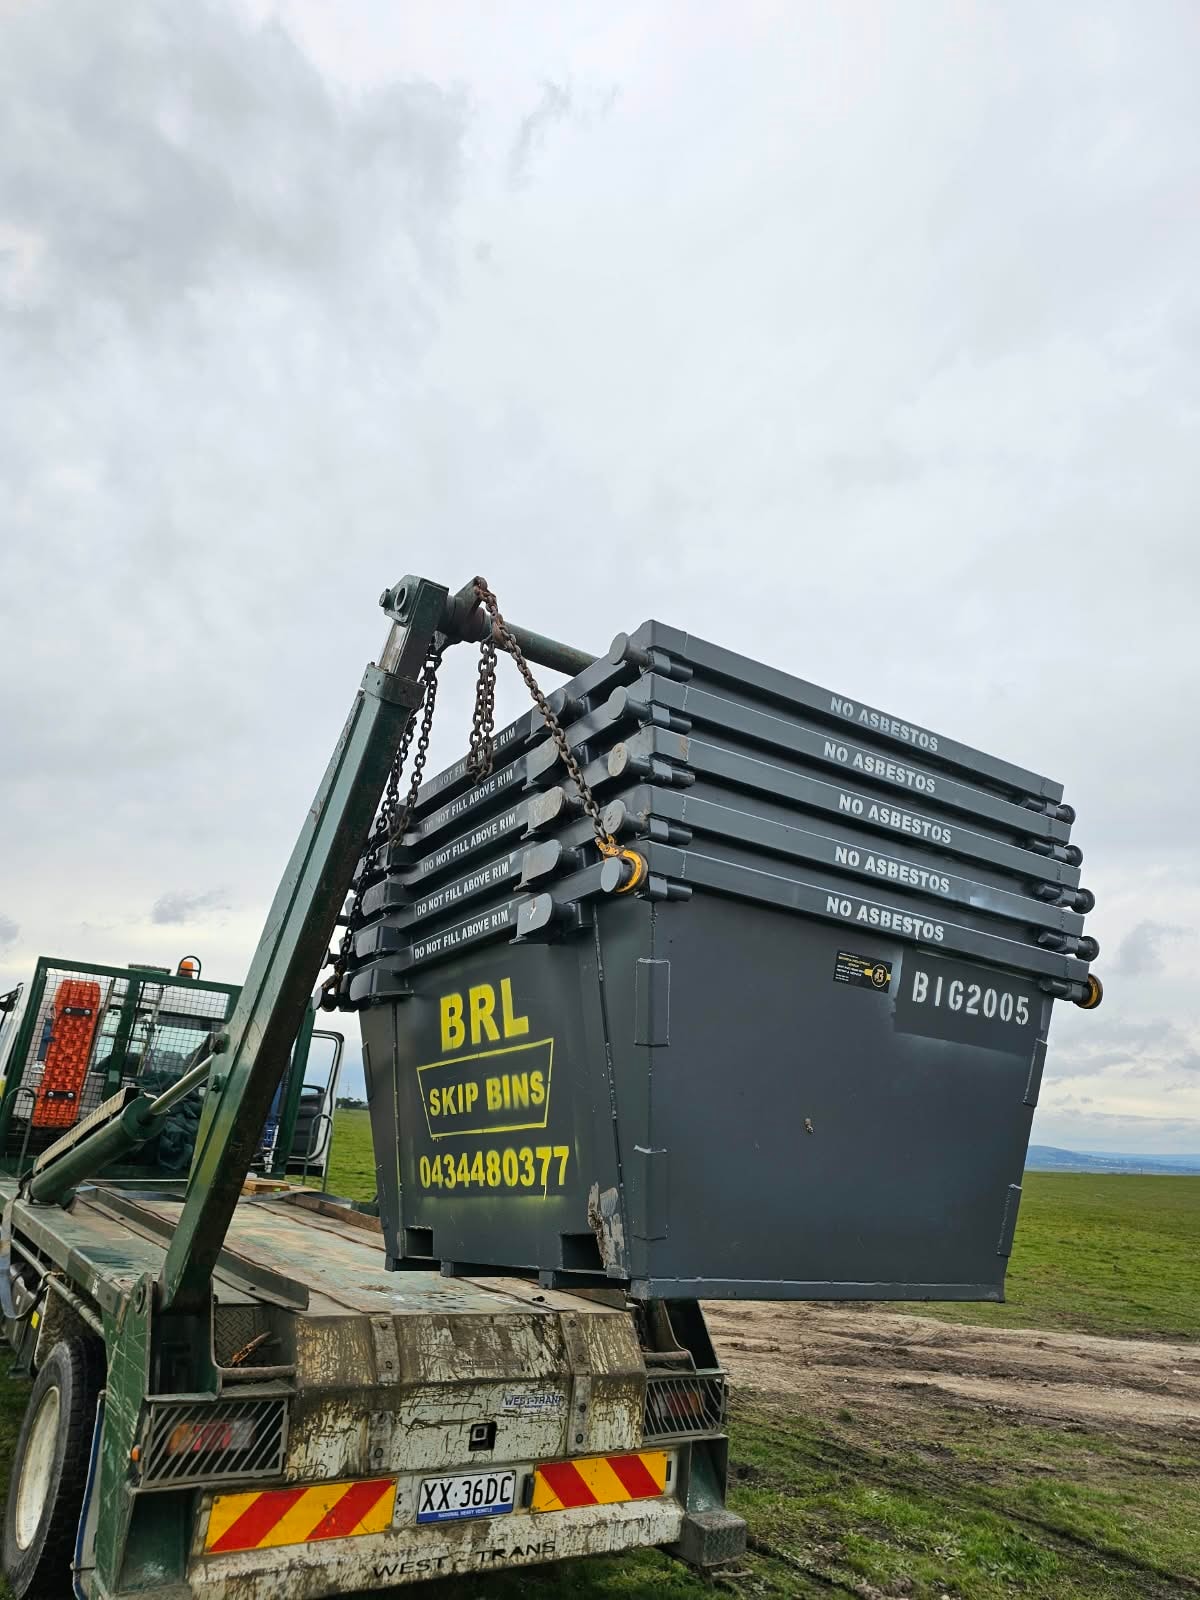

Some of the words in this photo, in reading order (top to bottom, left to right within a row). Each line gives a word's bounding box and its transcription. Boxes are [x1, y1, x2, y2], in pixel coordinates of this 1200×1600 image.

[500, 727, 516, 746] RIM
[830, 697, 854, 717] NO
[859, 709, 939, 752] ASBESTOS
[824, 741, 848, 763] NO
[853, 753, 936, 793] ASBESTOS
[436, 809, 450, 823] NOT
[451, 798, 468, 816] FILL
[469, 780, 496, 805] ABOVE
[497, 768, 513, 788] RIM
[838, 793, 863, 815] NO
[868, 805, 952, 844] ASBESTOS
[424, 860, 434, 873] DO
[436, 850, 451, 868] NOT
[452, 839, 470, 858] FILL
[470, 823, 498, 847] ABOVE
[500, 812, 516, 830] RIM
[417, 904, 427, 916] DO
[428, 894, 443, 911] NOT
[445, 883, 462, 902] FILL
[463, 869, 491, 893] ABOVE
[492, 861, 509, 879] RIM
[835, 846, 860, 867] NO
[864, 856, 950, 894] ASBESTOS
[414, 947, 424, 959] DO
[426, 938, 441, 954] NOT
[443, 928, 461, 947] FILL
[462, 915, 490, 939] ABOVE
[492, 909, 509, 926] RIM
[826, 896, 851, 917] NO
[856, 905, 944, 941] ASBESTOS
[440, 977, 529, 1052] BRL
[912, 971, 1029, 1025] BIG2005
[429, 1082, 479, 1117] SKIP
[486, 1070, 545, 1112] BINS
[419, 1145, 570, 1189] 0434480377
[373, 1557, 446, 1579] WEST
[476, 1541, 556, 1564] TRANS
